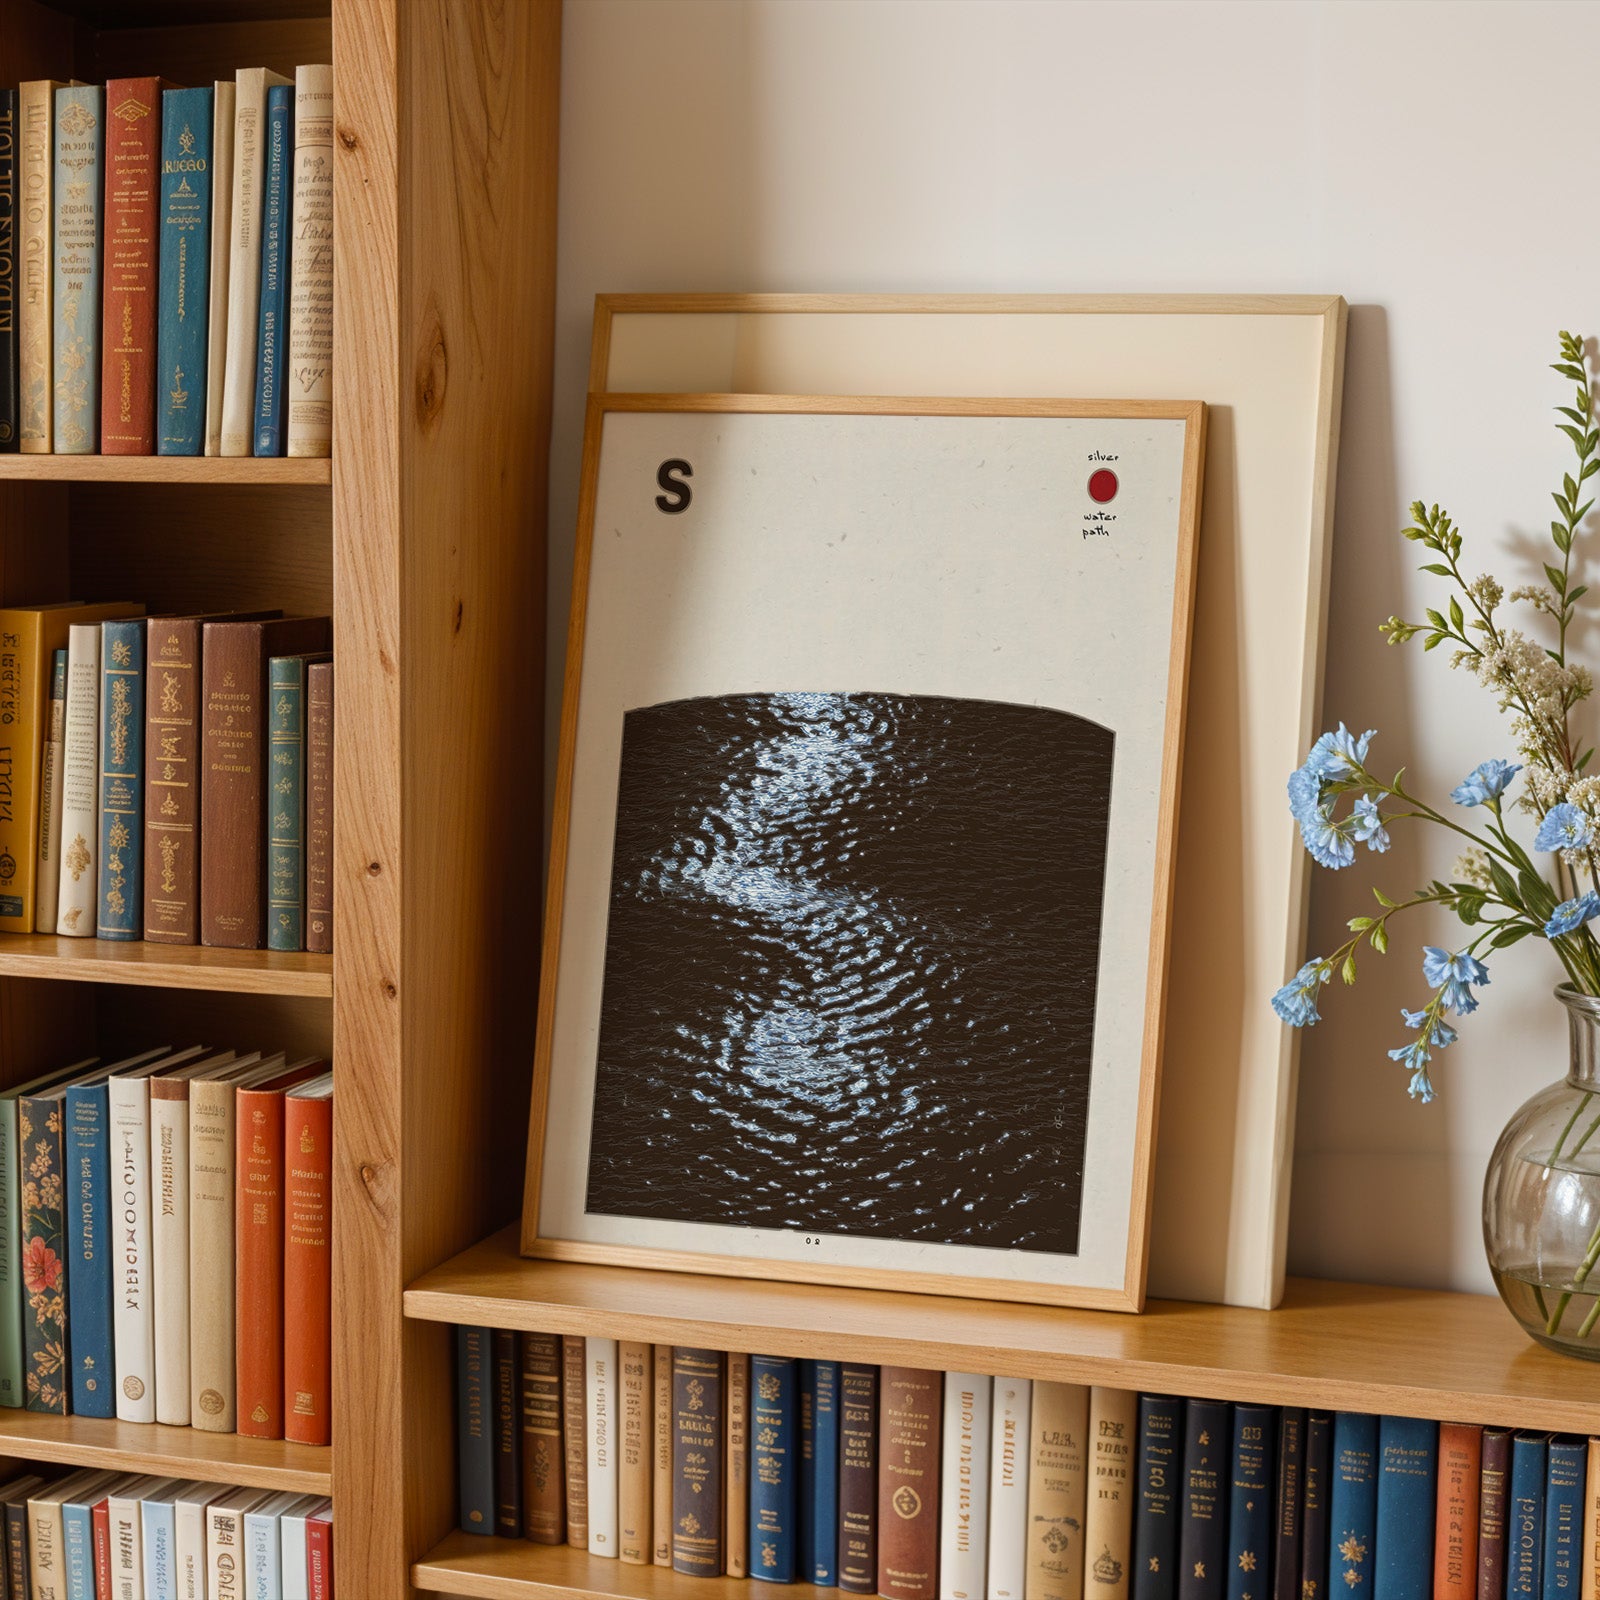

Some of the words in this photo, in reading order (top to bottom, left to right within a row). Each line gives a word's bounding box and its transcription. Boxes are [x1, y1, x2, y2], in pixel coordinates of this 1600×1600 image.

[1087, 450, 1120, 461] silver
[655, 458, 693, 515] S
[1083, 511, 1117, 521] water
[1082, 524, 1110, 540] path
